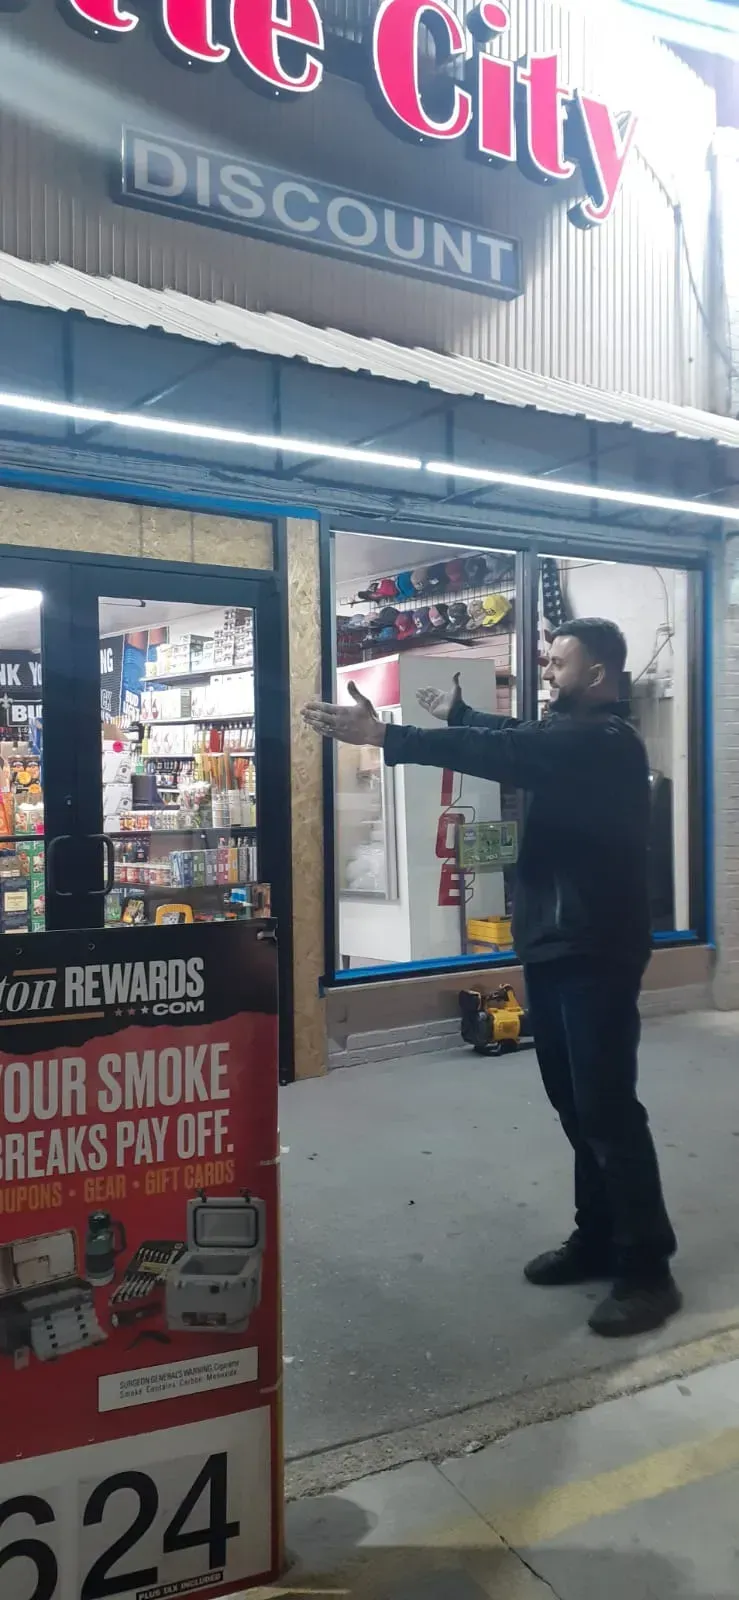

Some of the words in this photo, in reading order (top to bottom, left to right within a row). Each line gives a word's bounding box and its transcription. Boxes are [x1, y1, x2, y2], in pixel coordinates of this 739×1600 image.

[372, 0, 639, 222] City
[133, 137, 513, 282] DISCOUNT
[64, 957, 205, 1008] REWARDS
[152, 1000, 205, 1016] COM
[0, 1056, 87, 1124] OUR
[97, 1042, 230, 1113] SMOKE
[0, 1123, 108, 1181] REAKS
[116, 1116, 169, 1168] PAY
[177, 1109, 234, 1159] OFF.
[84, 1174, 127, 1203] GEAR
[145, 1166, 181, 1196] GIFT
[184, 1159, 235, 1188] CARDS
